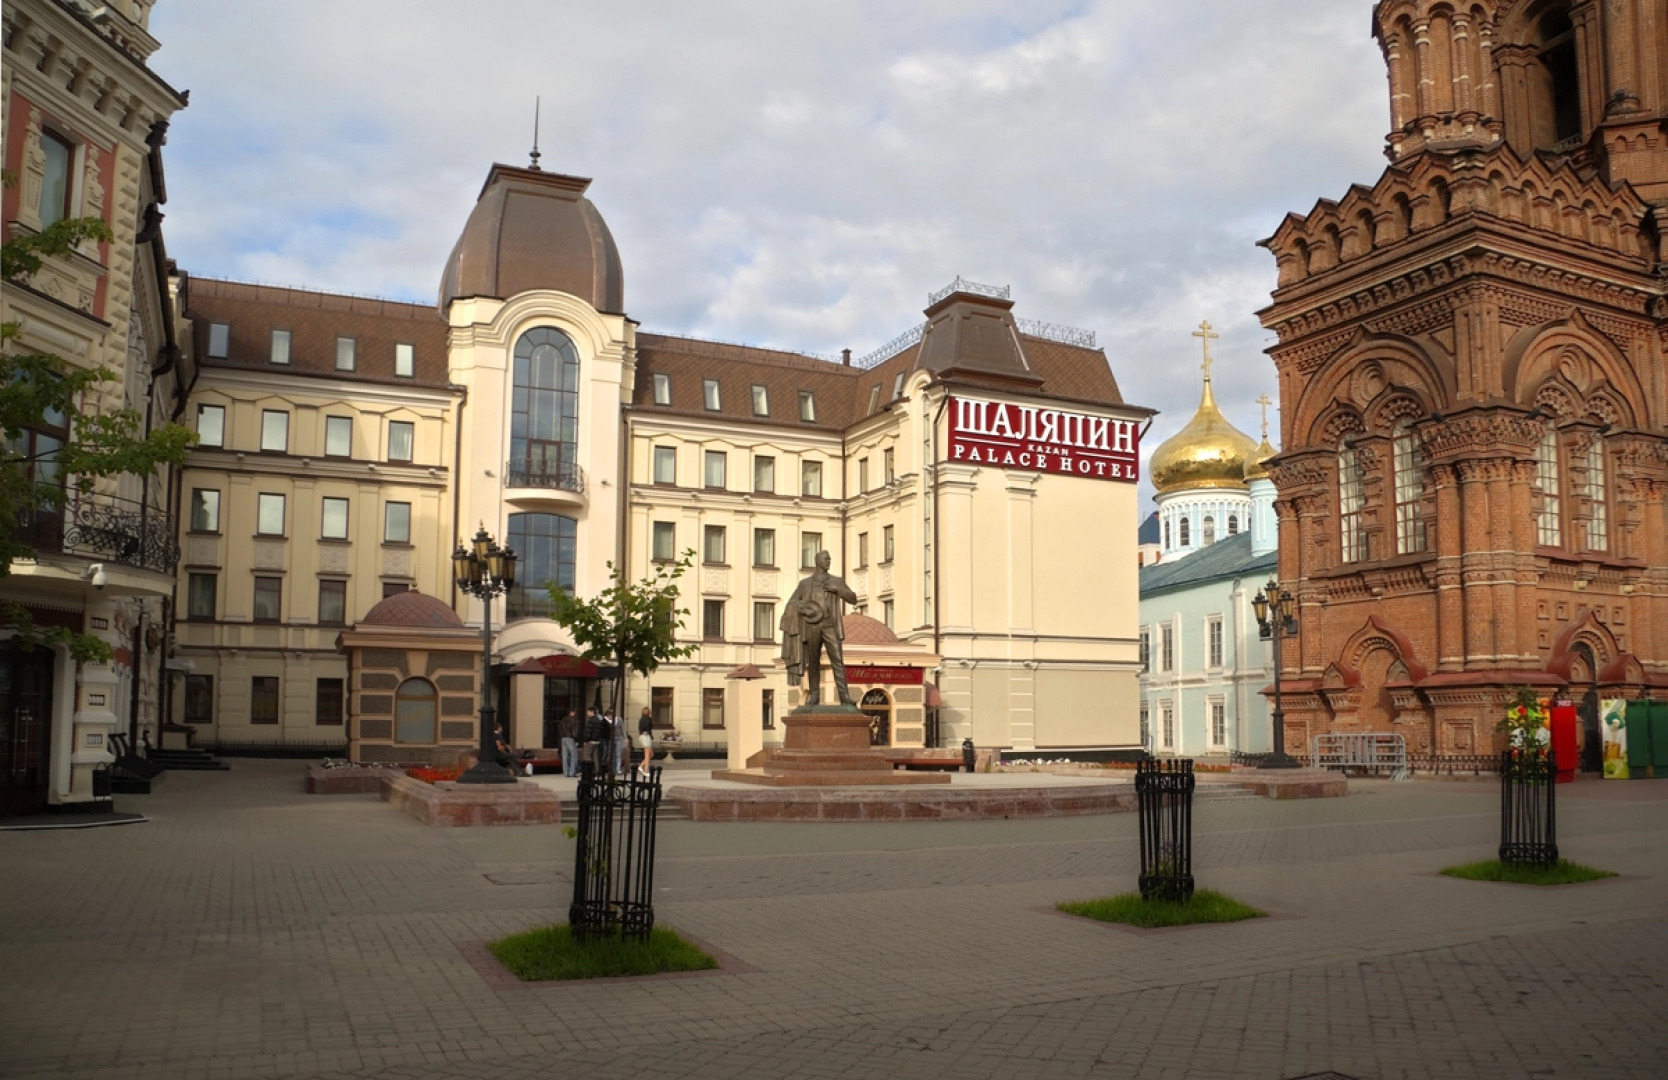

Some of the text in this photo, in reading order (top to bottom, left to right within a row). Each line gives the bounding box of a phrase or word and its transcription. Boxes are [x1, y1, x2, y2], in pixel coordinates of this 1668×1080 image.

[954, 397, 1135, 453] ШАЛЯПИН
[954, 444, 1136, 479] PALACE HOTEL
[1027, 444, 1069, 456] KAZAN
